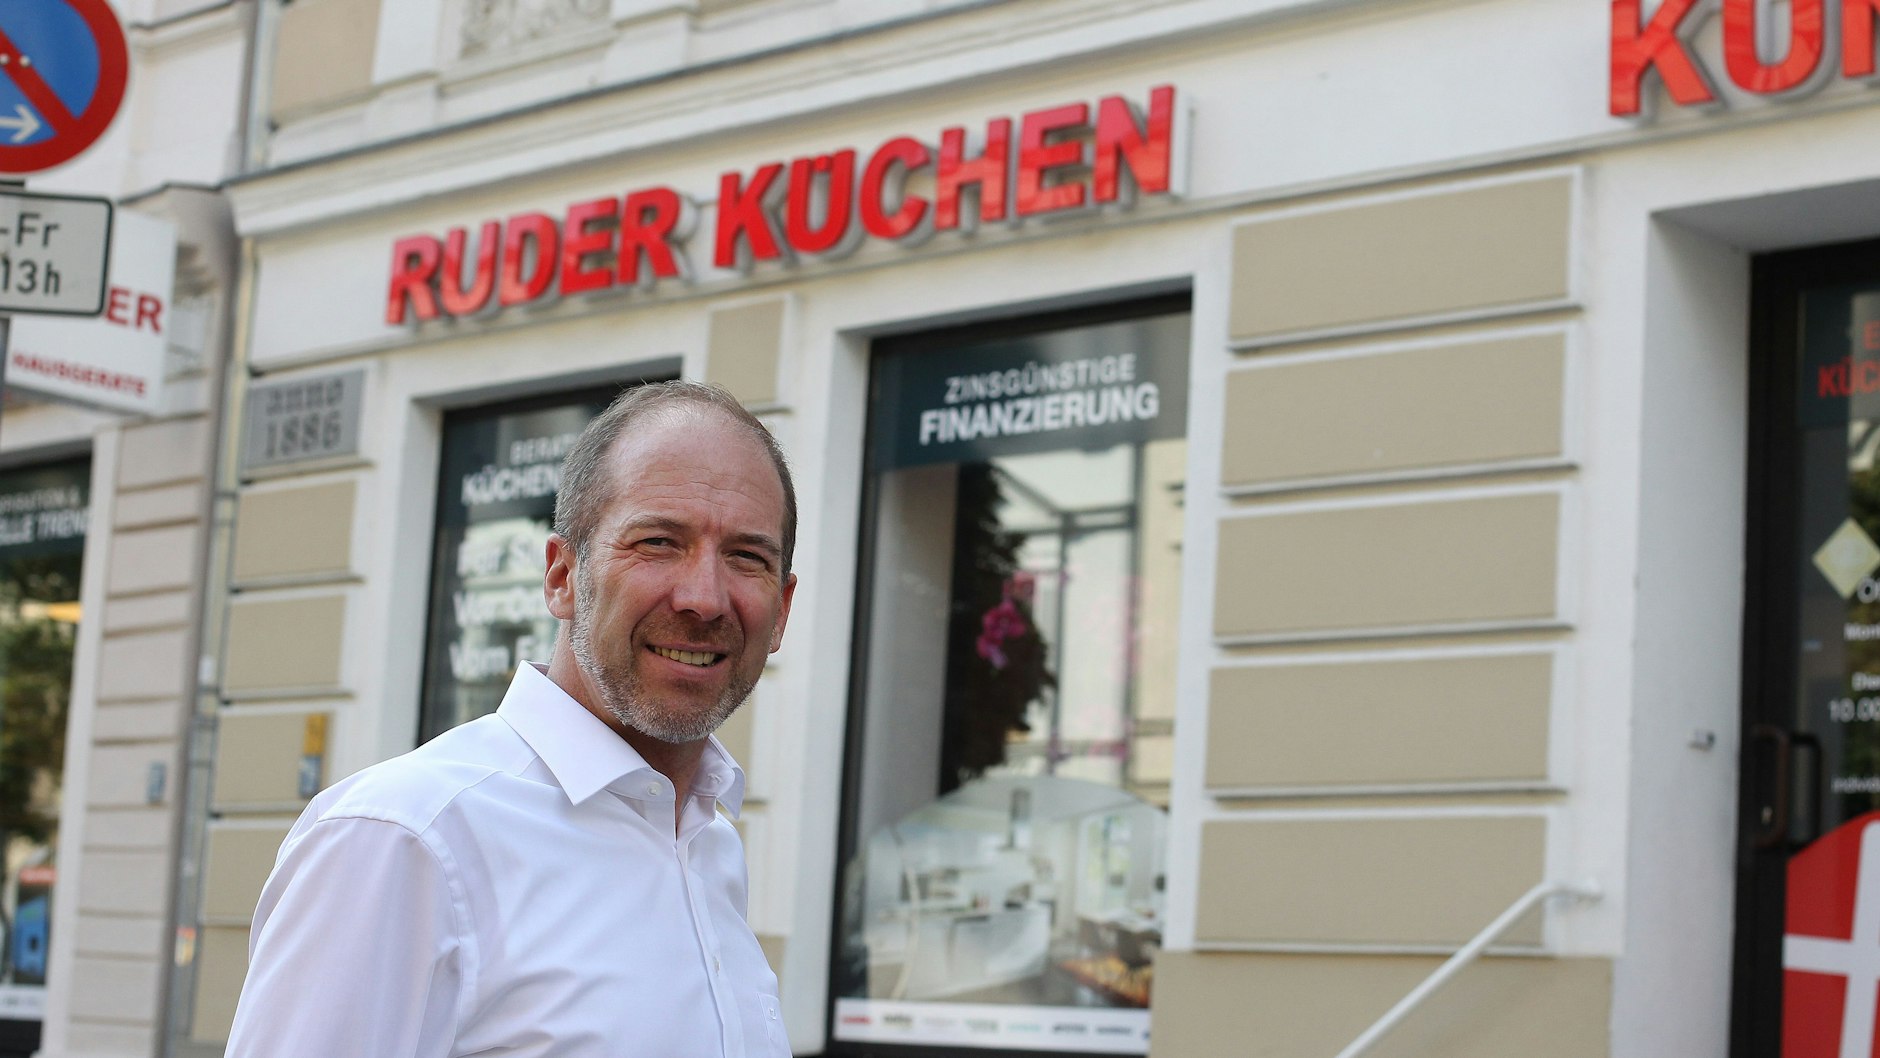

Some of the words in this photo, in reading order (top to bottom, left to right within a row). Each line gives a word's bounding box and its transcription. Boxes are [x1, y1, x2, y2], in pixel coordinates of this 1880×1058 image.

[386, 186, 680, 326] RUDER
[713, 84, 1176, 269] KÜCHEN
[943, 352, 1137, 404] ZINSGÜNSTIGE
[264, 409, 343, 459] 1886
[918, 382, 1160, 446] FINANZIERUNG
